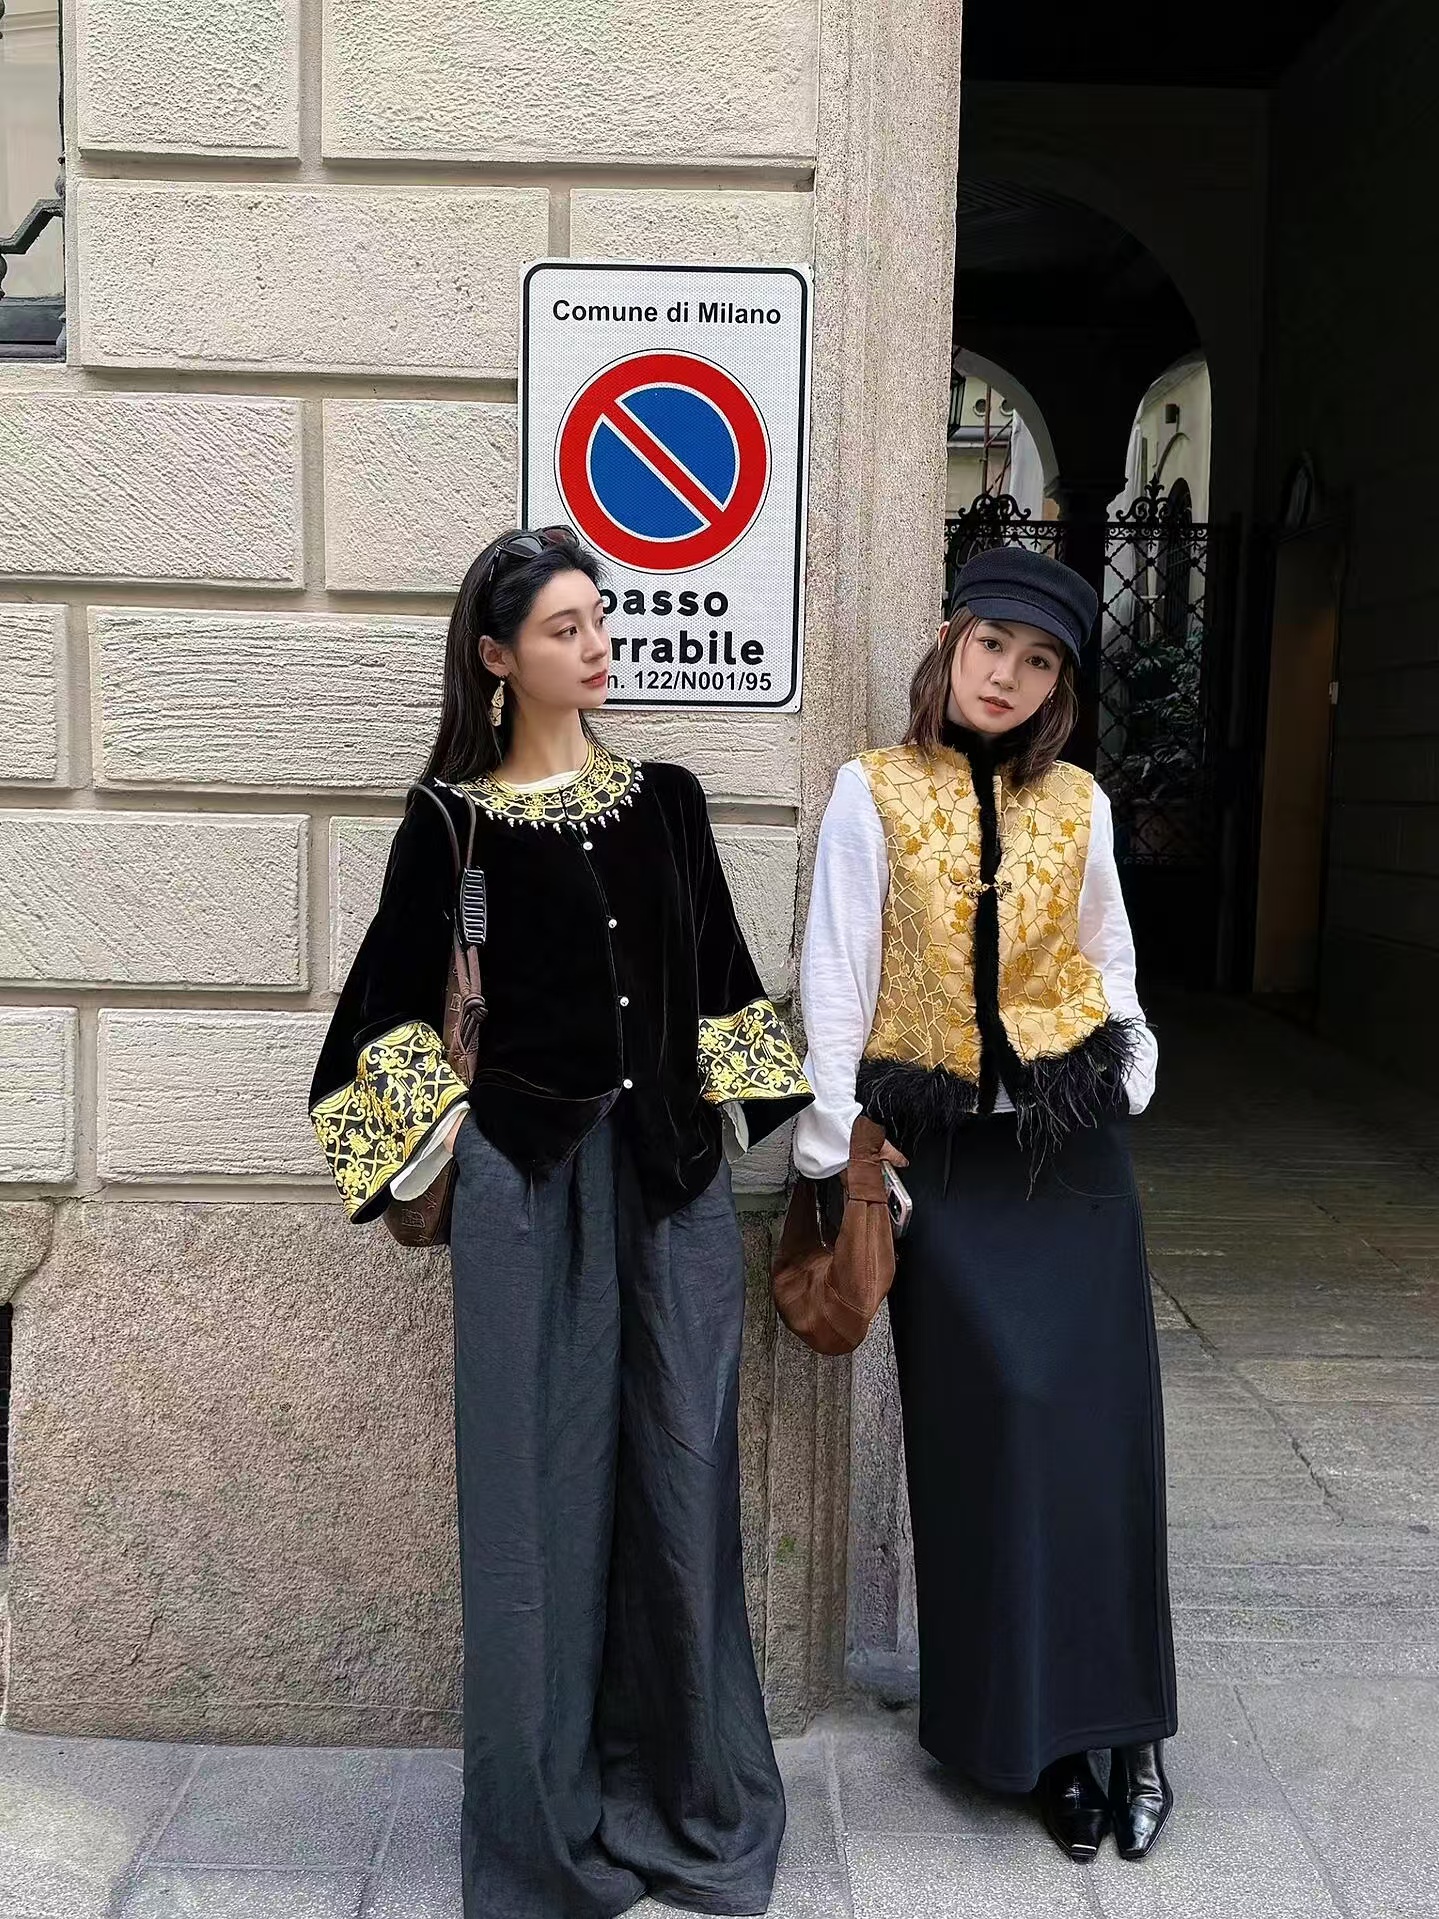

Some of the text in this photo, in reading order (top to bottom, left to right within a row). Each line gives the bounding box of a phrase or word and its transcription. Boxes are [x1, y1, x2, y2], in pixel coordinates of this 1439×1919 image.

[552, 299, 781, 325] Comune di Milano
[610, 629, 765, 666] rrabile
[634, 670, 772, 691] 122/N001/95
